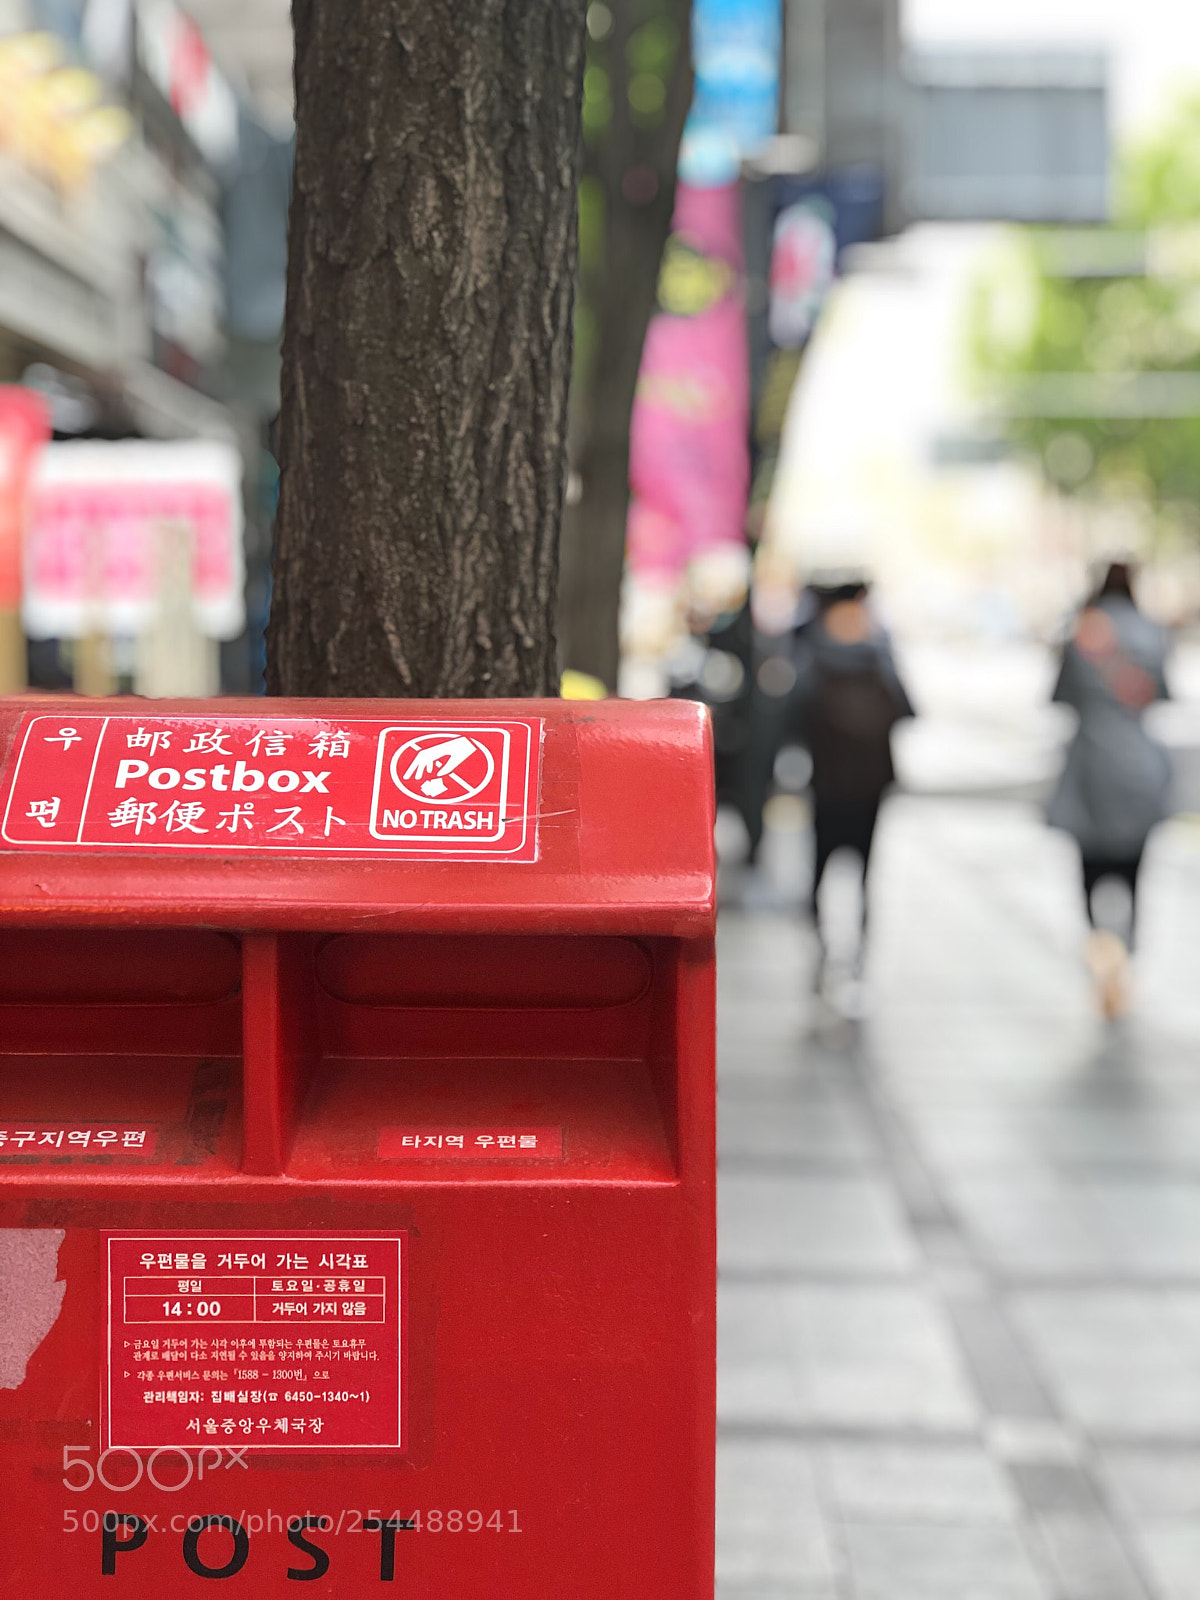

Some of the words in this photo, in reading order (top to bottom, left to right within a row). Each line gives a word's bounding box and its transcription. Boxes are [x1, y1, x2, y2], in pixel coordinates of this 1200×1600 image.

[126, 726, 351, 759] 邮政信箱
[114, 759, 332, 794] Postbox
[107, 796, 347, 837] 郵便ポスト
[382, 809, 418, 829] NO
[420, 810, 494, 830] TRASH
[401, 1135, 464, 1149] 타지역
[474, 1135, 539, 1149] 우편물
[139, 1252, 207, 1270] 우편물을
[217, 1252, 266, 1270] 거두어
[276, 1252, 309, 1270] 가는
[318, 1252, 369, 1270] 시각표
[177, 1279, 202, 1293] 평일
[272, 1302, 308, 1316] 거두어
[312, 1302, 338, 1316] 가지
[341, 1302, 367, 1317] 않음
[133, 1338, 160, 1350] 금요일
[162, 1338, 188, 1350] 거두어
[190, 1338, 209, 1350] 가는
[210, 1338, 228, 1350] 시각
[230, 1338, 256, 1350] 이후에
[295, 1338, 330, 1350] 우편물은
[332, 1338, 367, 1350] 토요휴무
[133, 1350, 160, 1361] 관계로
[161, 1350, 188, 1361] 배달이
[190, 1350, 208, 1361] 다소
[238, 1350, 248, 1361] 수
[250, 1350, 276, 1361] 있음을
[315, 1350, 340, 1361] 주시기
[136, 1370, 155, 1381] 각종
[157, 1370, 200, 1381] 우편서비스
[202, 1370, 229, 1381] 문의는
[312, 1370, 330, 1379] 으로
[143, 1390, 204, 1403] 관리책임자:
[185, 1417, 325, 1435] 서울중앙우체국장
[101, 1513, 415, 1582] POST
